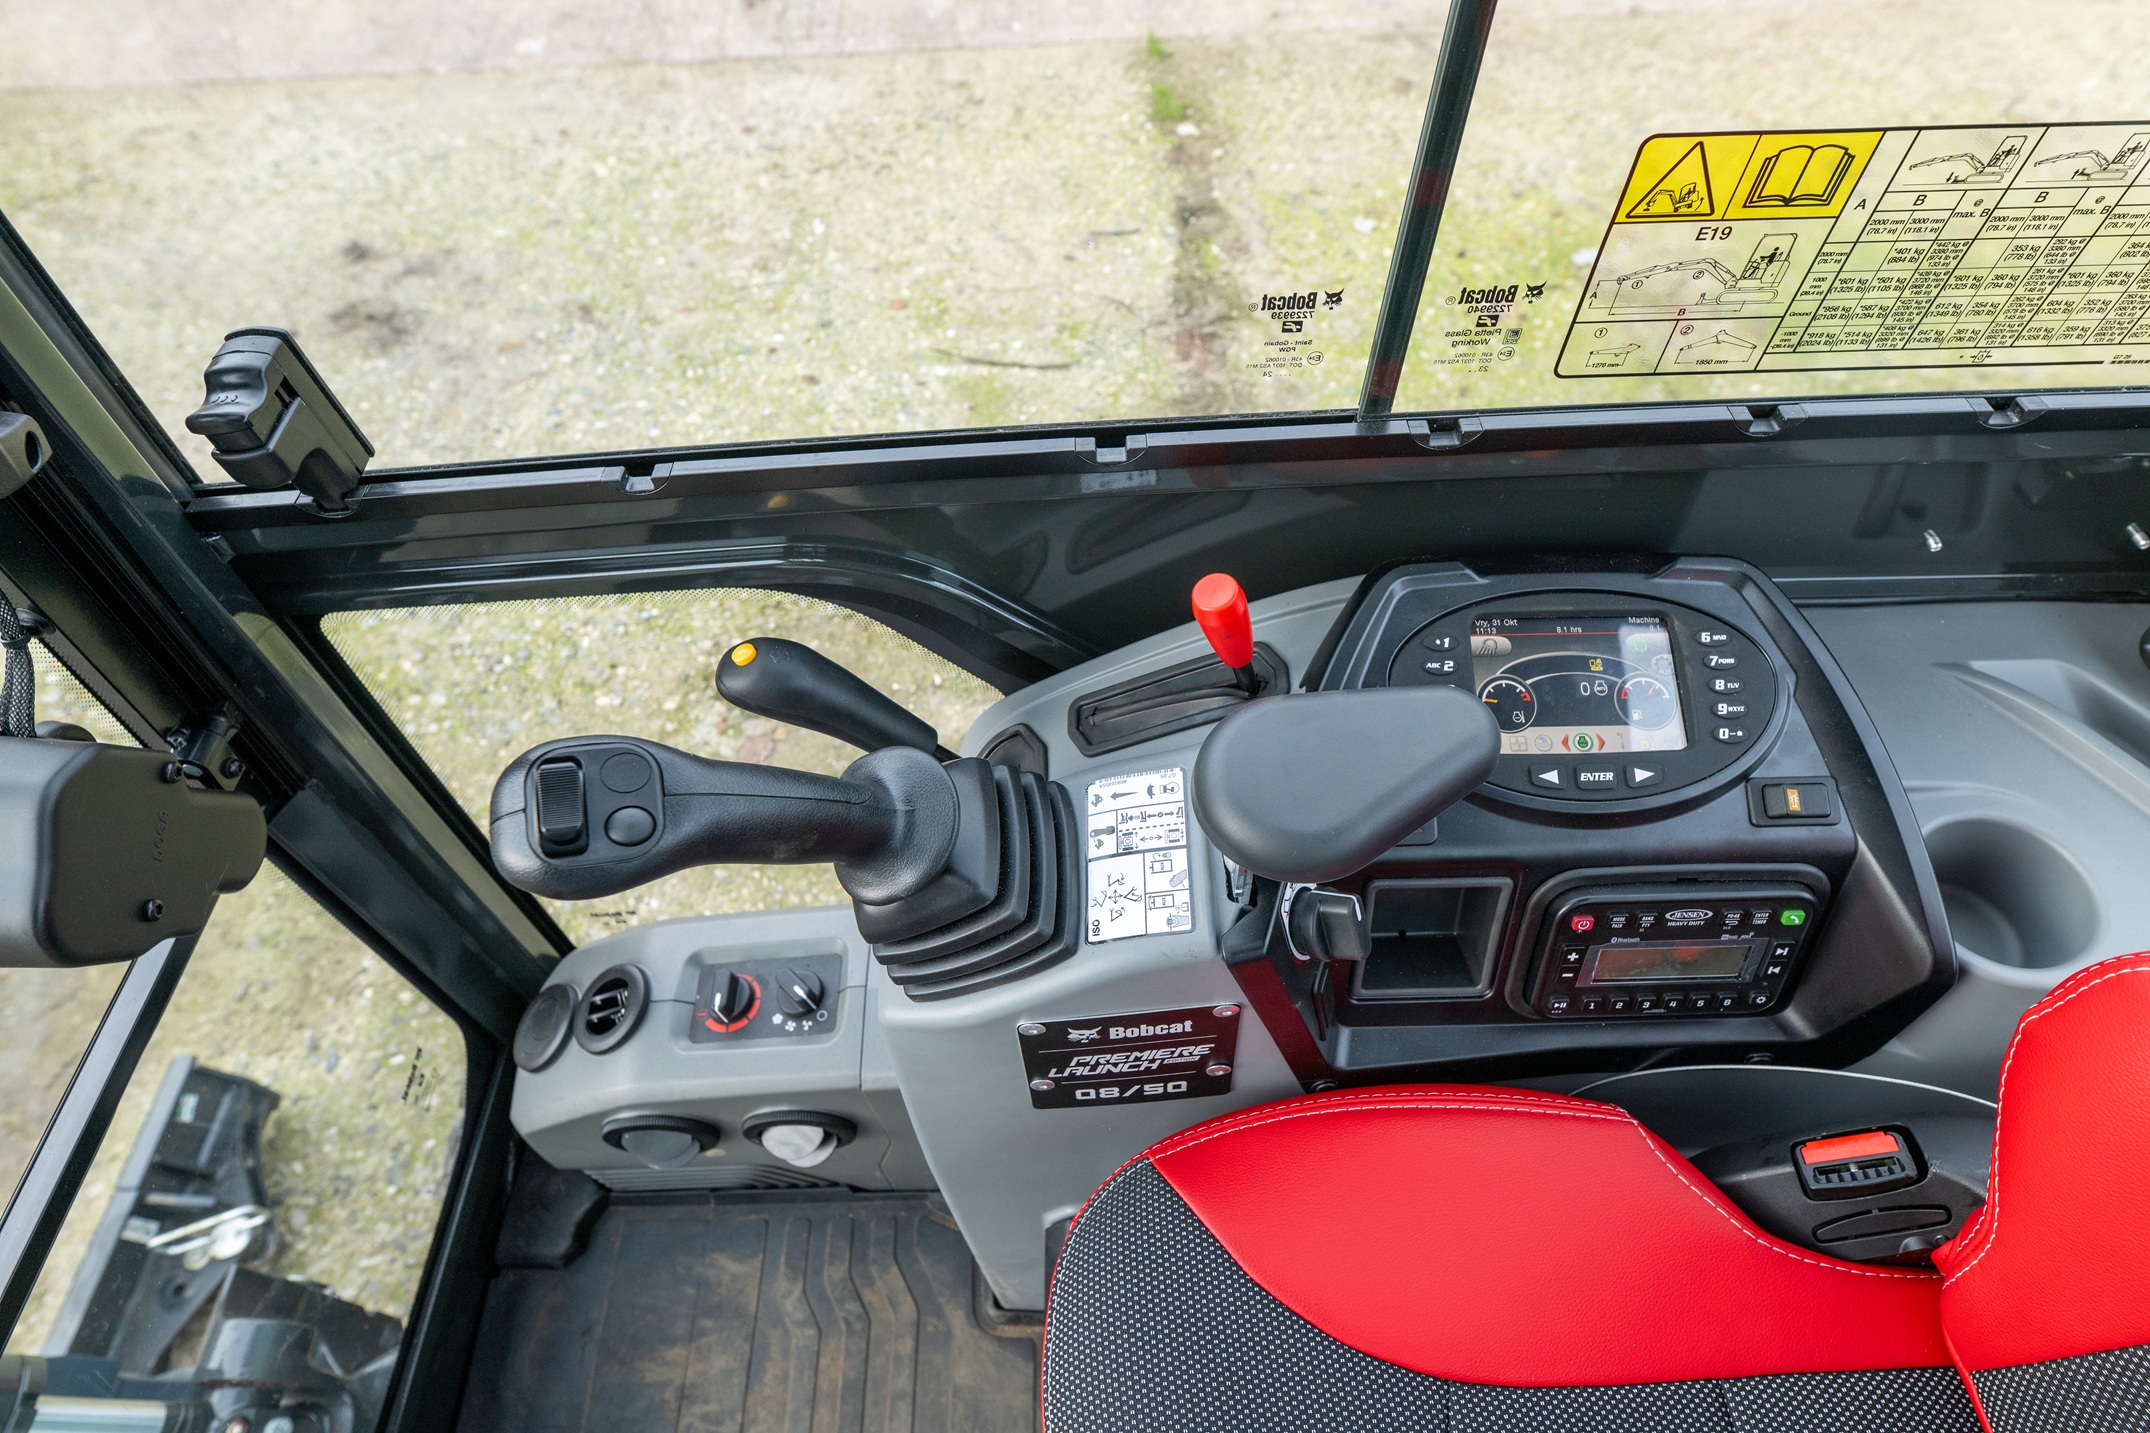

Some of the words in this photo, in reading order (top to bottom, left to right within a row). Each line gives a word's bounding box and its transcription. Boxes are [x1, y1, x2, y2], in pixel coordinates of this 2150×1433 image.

[1912, 194, 1927, 206] B
[2034, 191, 2049, 203] B
[2095, 196, 2105, 204] @
[1854, 198, 1867, 210] A
[1973, 199, 1984, 207] @
[1980, 208, 1991, 218] B
[2072, 207, 2096, 215] max.
[2100, 205, 2112, 215] B
[1985, 224, 2005, 232] (78.7
[2006, 224, 2017, 232] in)
[2023, 224, 2048, 232] (118.1
[2048, 223, 2059, 231] in)
[2104, 221, 2124, 229] (78.7
[2125, 221, 2136, 229] in)
[1695, 226, 1733, 241] E19
[1886, 227, 1898, 235] in)
[1904, 226, 1928, 235] (118.1
[1929, 226, 1940, 234] in)
[2123, 271, 2135, 279] kg
[1857, 278, 1869, 286] kg
[1896, 277, 1907, 285] kg
[2118, 279, 2130, 287] lb)
[1829, 285, 1853, 294] (1325
[1855, 285, 1867, 293] lb)
[1867, 285, 1892, 293] (1105
[1838, 313, 1850, 321] lb)
[1875, 312, 1887, 320] lb)
[1985, 309, 1996, 317] lb)
[1628, 616, 1660, 624] Machine
[1701, 632, 1711, 643] 6
[1443, 637, 1450, 648] 1
[1709, 655, 1719, 667] 7
[1443, 660, 1454, 672] 2
[1715, 679, 1725, 690] 8
[1717, 703, 1728, 715] 9
[1719, 728, 1729, 739] 0
[1580, 771, 1614, 782] ENTER
[1671, 911, 1705, 919] JENSEN
[1092, 919, 1101, 937] ISO
[1697, 999, 1705, 1007] 5
[1723, 998, 1731, 1006] 6
[1109, 1020, 1193, 1040] Bobcat
[1069, 1043, 1216, 1067] PREMIERE
[1047, 1059, 1161, 1078] LAUNCH
[1164, 1056, 1199, 1064] EDITION
[1075, 1080, 1188, 1100] 08/50
